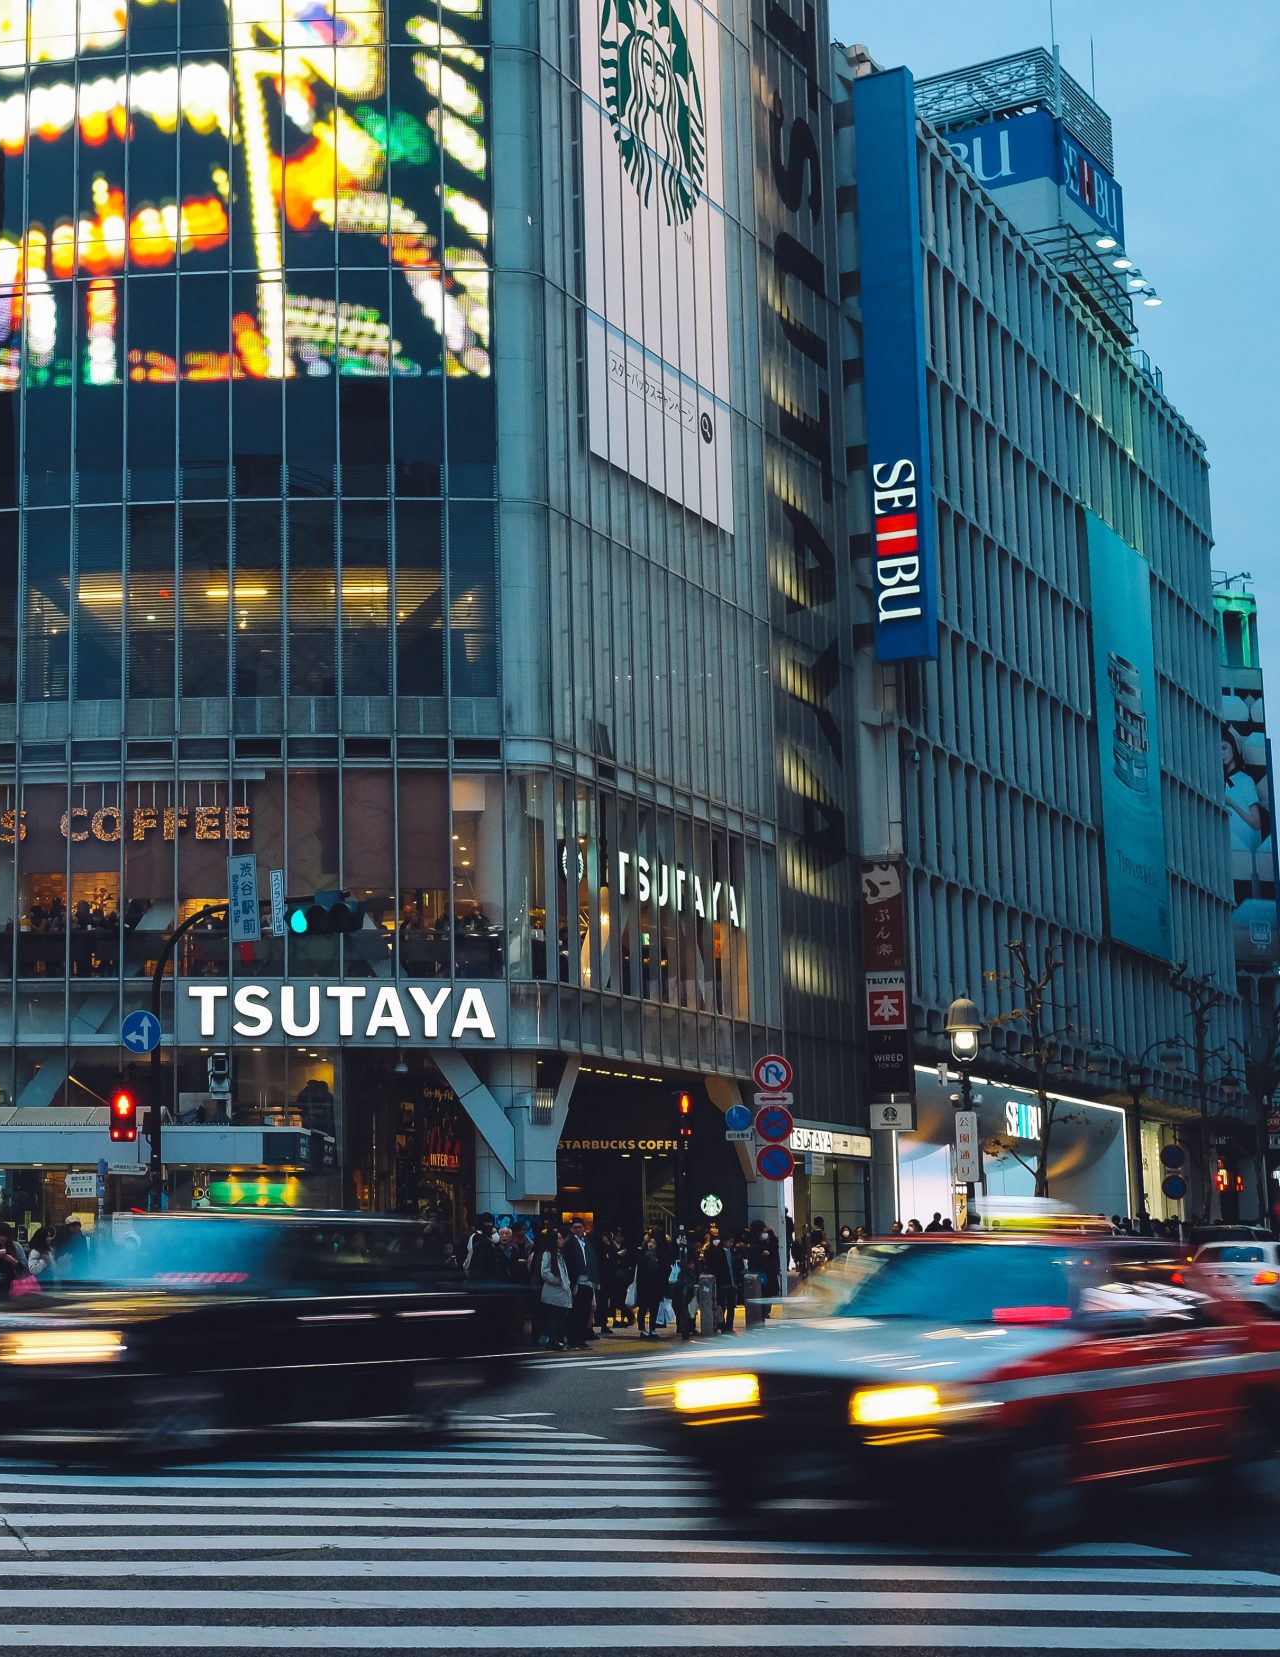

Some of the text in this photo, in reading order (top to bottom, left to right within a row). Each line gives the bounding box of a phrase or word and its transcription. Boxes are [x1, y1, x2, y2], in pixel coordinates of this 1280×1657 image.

[1062, 138, 1119, 233] SEIBU
[872, 458, 922, 625] SEIBU
[59, 805, 251, 842] COFFEE
[239, 861, 256, 935] 渋谷駅前
[618, 850, 740, 928] TSUTAYA
[866, 976, 905, 985] TSUTAYA
[874, 995, 900, 1021] 本
[188, 984, 496, 1039] TSUTAYA
[874, 1053, 904, 1062] WIRED
[557, 1139, 636, 1150] STARBUCKS
[959, 1117, 970, 1176] 公園通り
